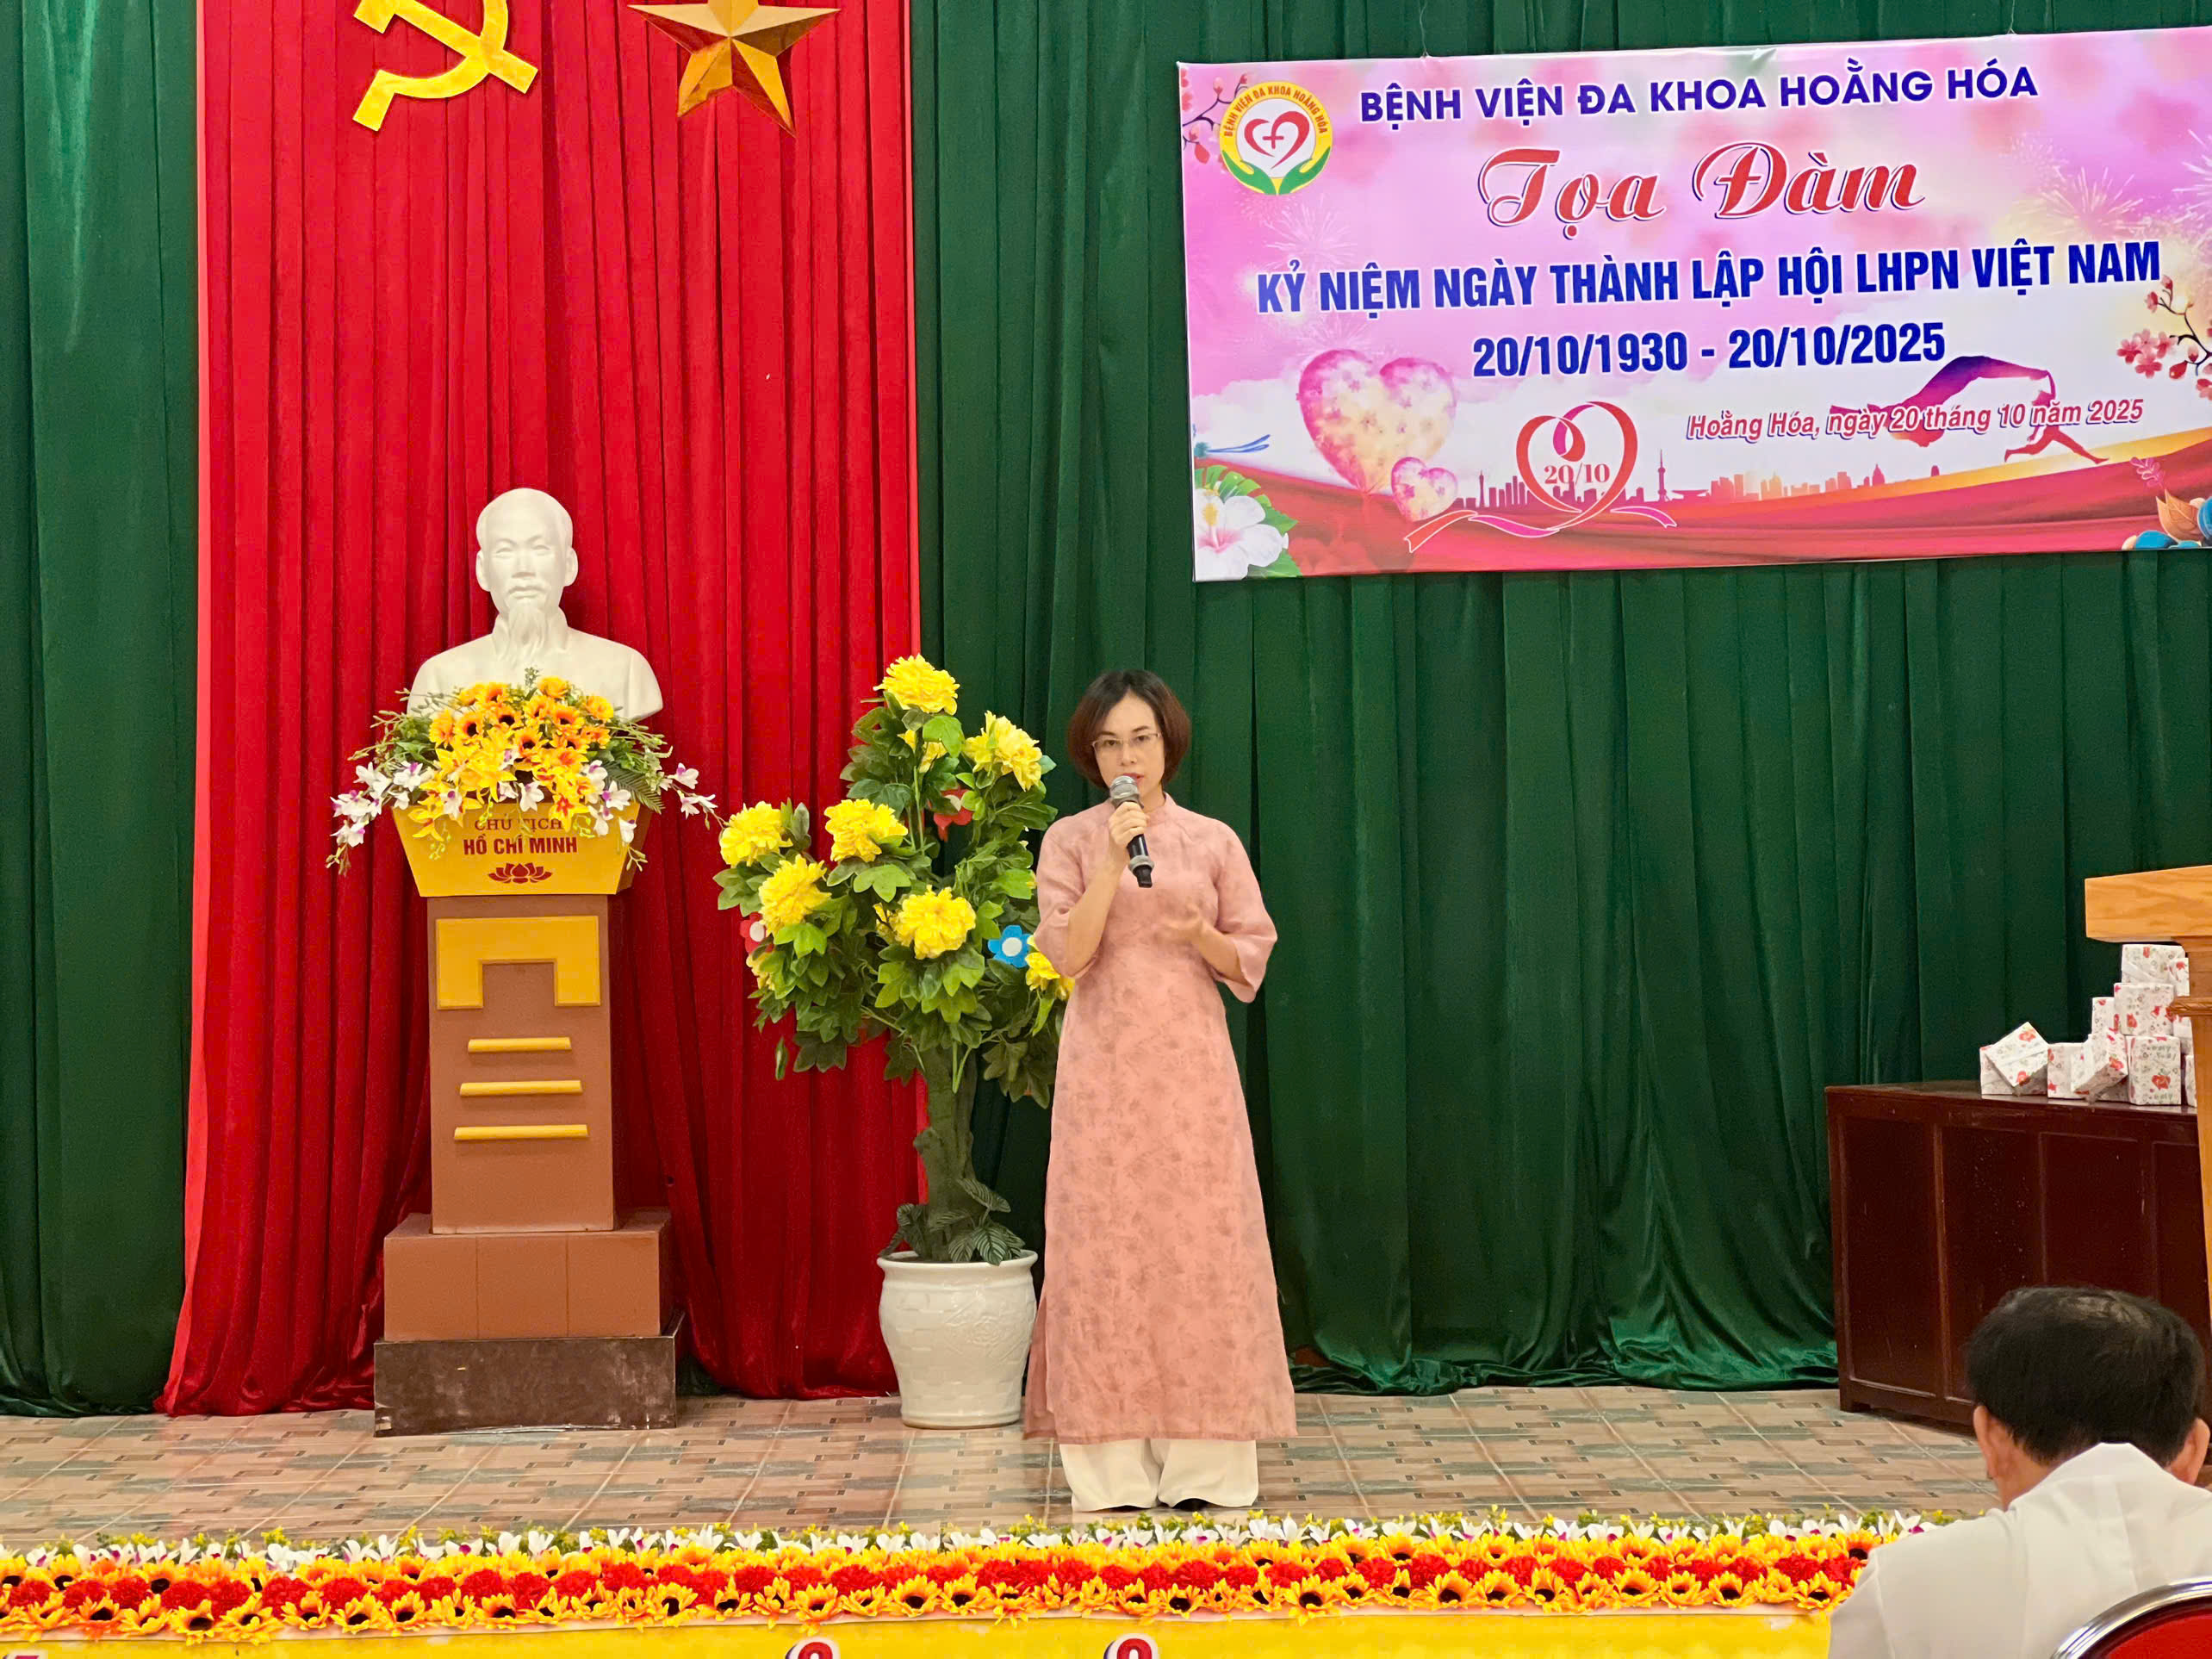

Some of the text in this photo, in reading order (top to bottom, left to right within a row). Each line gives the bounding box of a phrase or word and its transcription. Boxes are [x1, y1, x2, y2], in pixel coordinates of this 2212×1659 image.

[1268, 85, 1292, 96] KHOA
[1315, 112, 1327, 134] HÓA
[1361, 58, 2038, 130] BỆNH VIỆN ĐA KHOA HOẰNG HÓA
[1478, 140, 1926, 239] Tọa Đàm
[1257, 238, 2160, 319] KỶ NIỆM NGÀY THÀNH LẬP HỘI LHPN VIỆT NAM
[1473, 322, 1944, 377] 20/10/1930 - 20/10/2025
[1687, 399, 2144, 443] Hoằng Hóa, ngày 20 tháng 10 năm 2025
[1544, 462, 1611, 486] 20/10
[463, 834, 577, 855] HỒ CHÍ MINH
[475, 813, 512, 830] CHỦ
